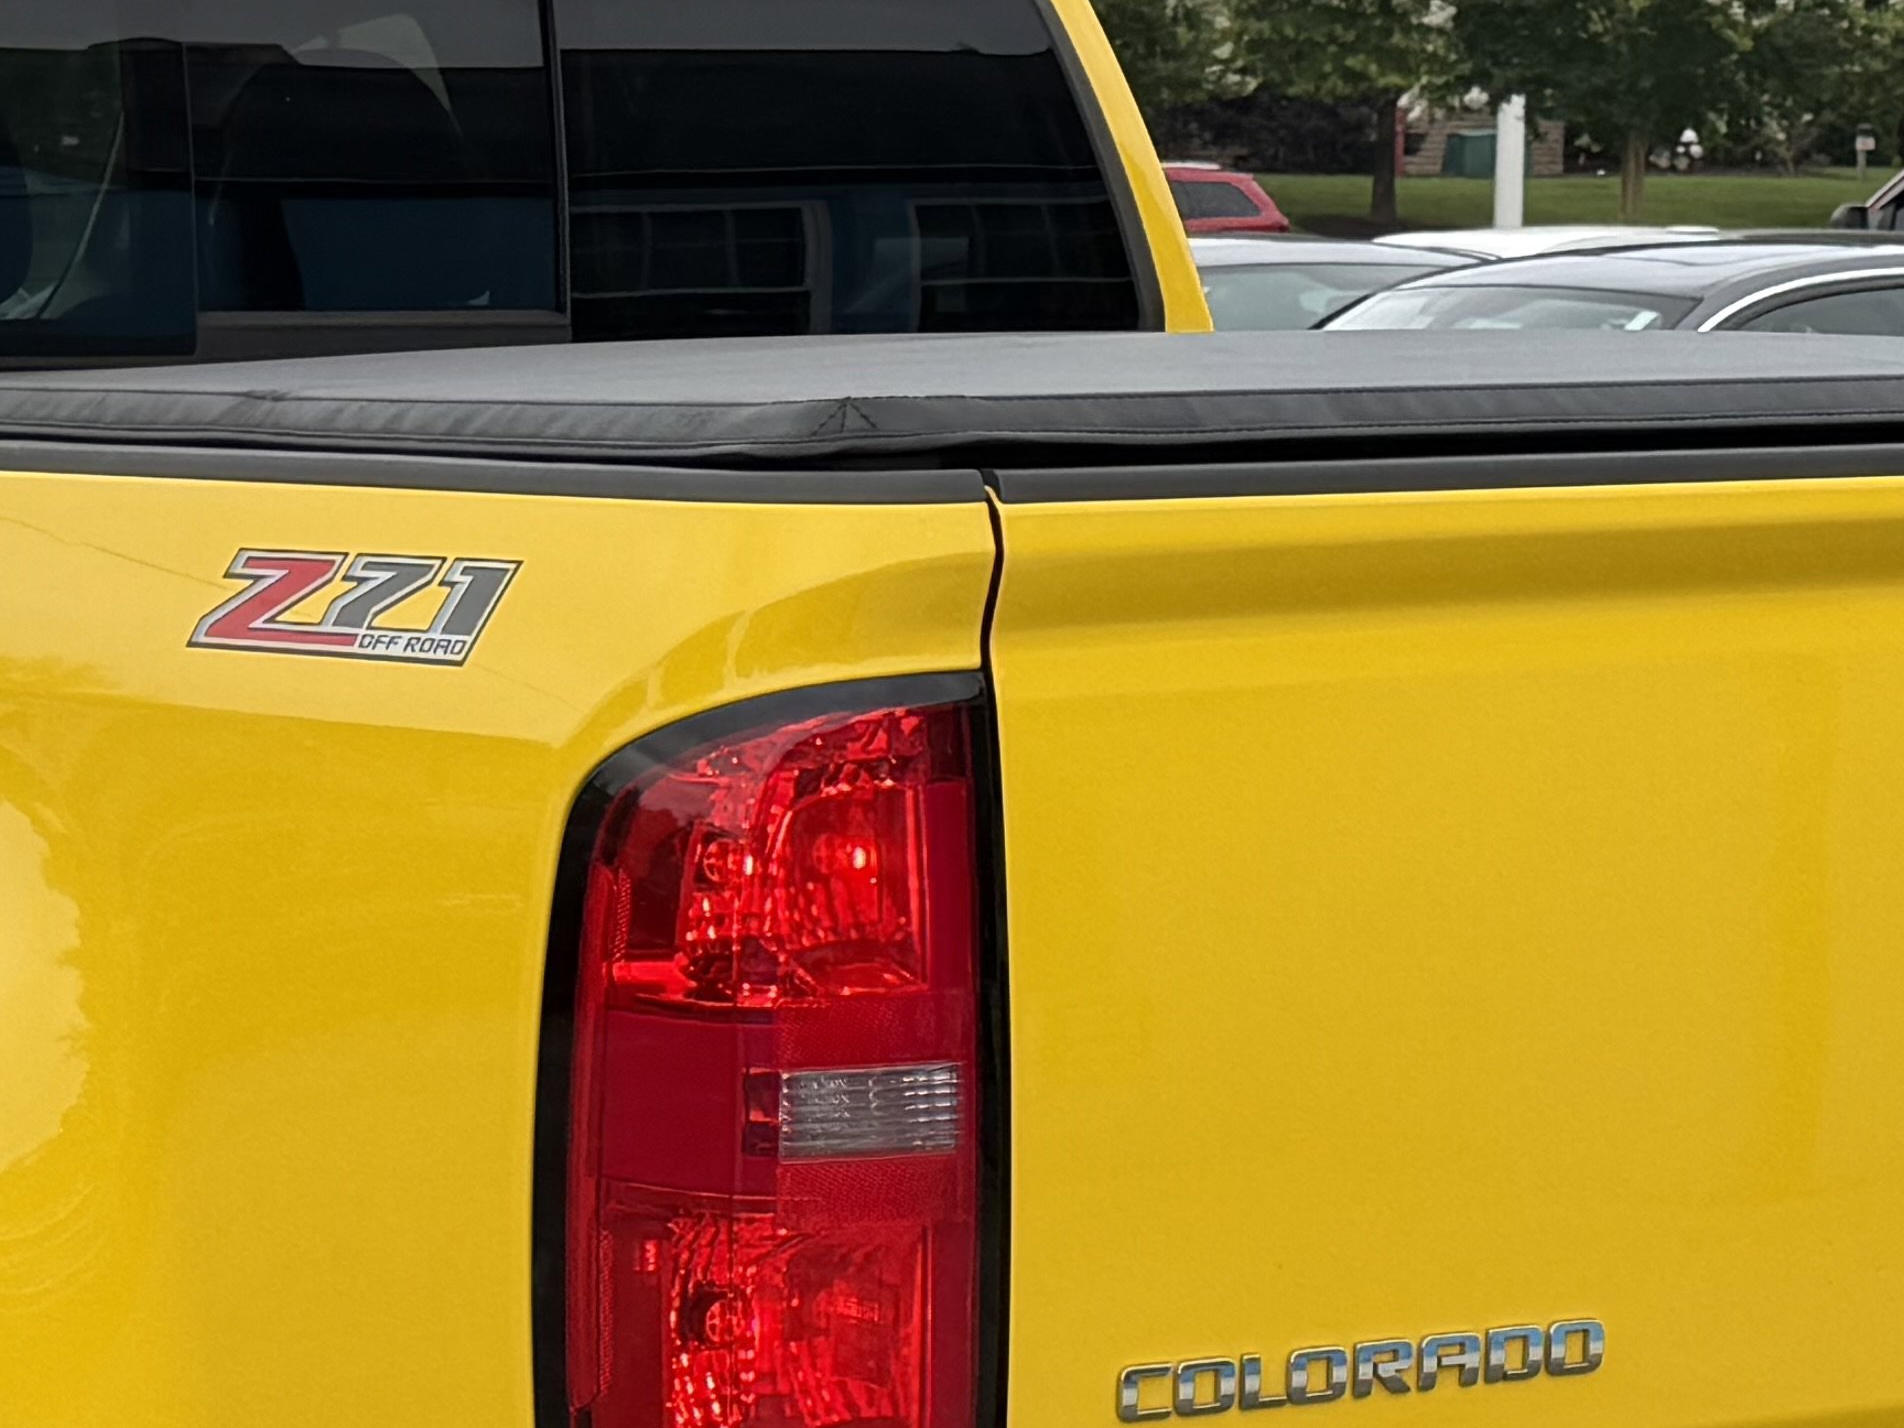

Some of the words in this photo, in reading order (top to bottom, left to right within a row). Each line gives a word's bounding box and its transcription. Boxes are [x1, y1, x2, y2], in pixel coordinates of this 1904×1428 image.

[185, 547, 524, 667] Z71
[358, 632, 402, 651] OFF
[402, 636, 468, 656] ROAD
[1115, 1318, 1607, 1423] COLORADO
